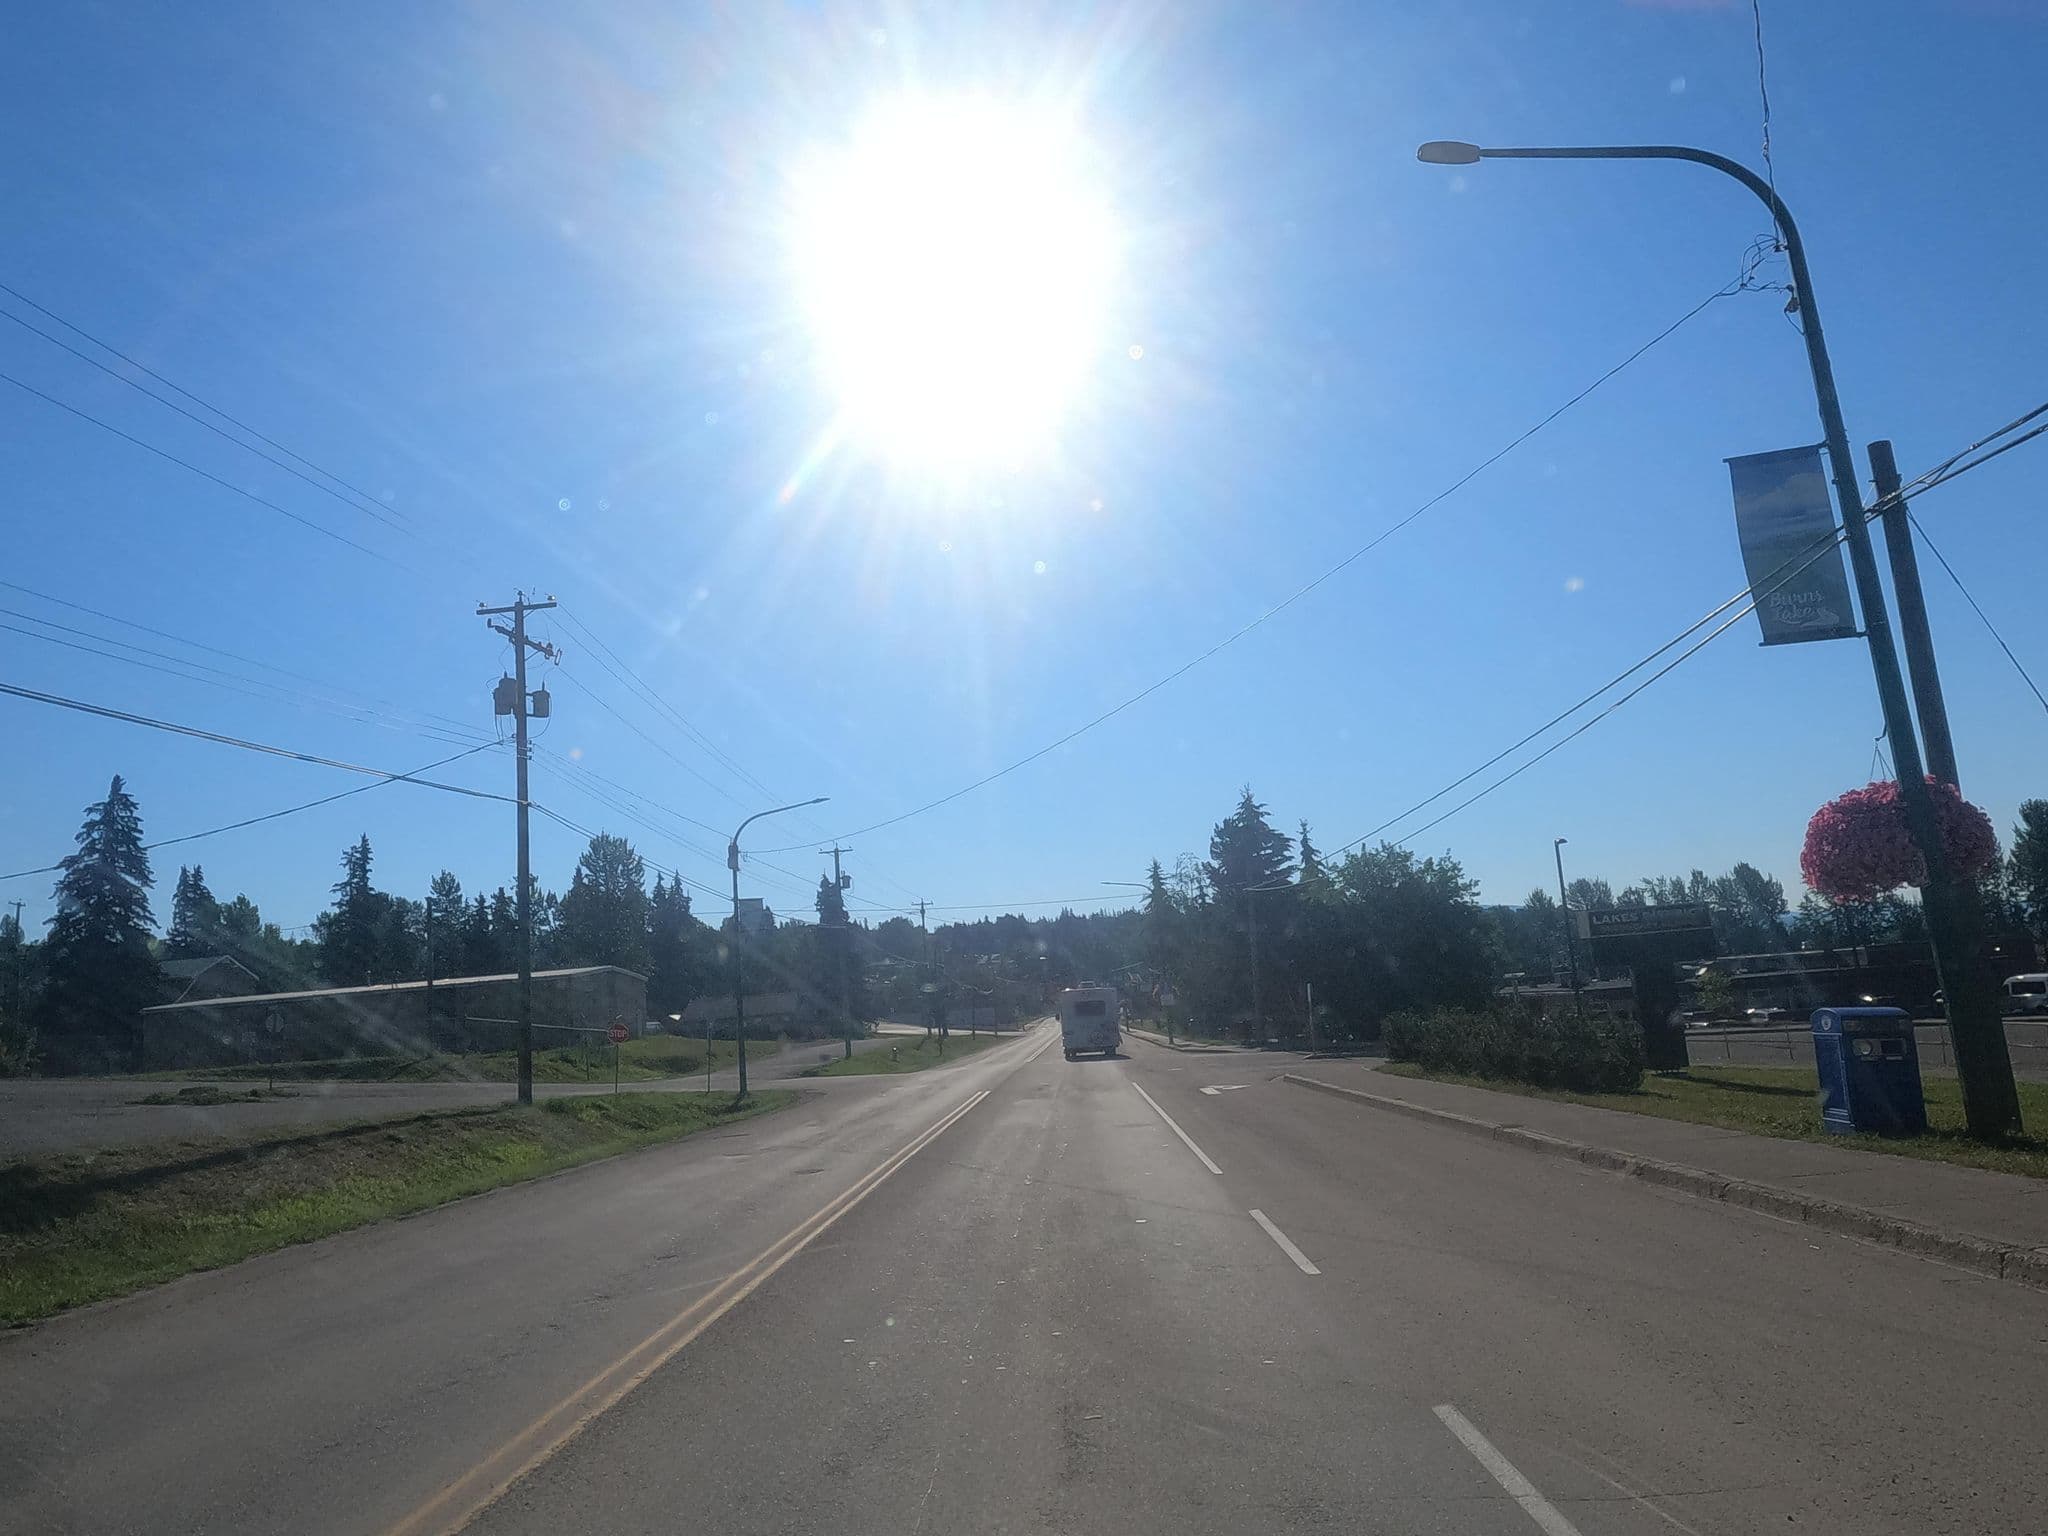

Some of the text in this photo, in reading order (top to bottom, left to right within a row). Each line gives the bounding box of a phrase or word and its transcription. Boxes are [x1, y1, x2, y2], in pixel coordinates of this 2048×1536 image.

[1768, 590, 1825, 607] Burns
[1592, 913, 1639, 925] LAKES
[609, 1029, 626, 1038] STOP
